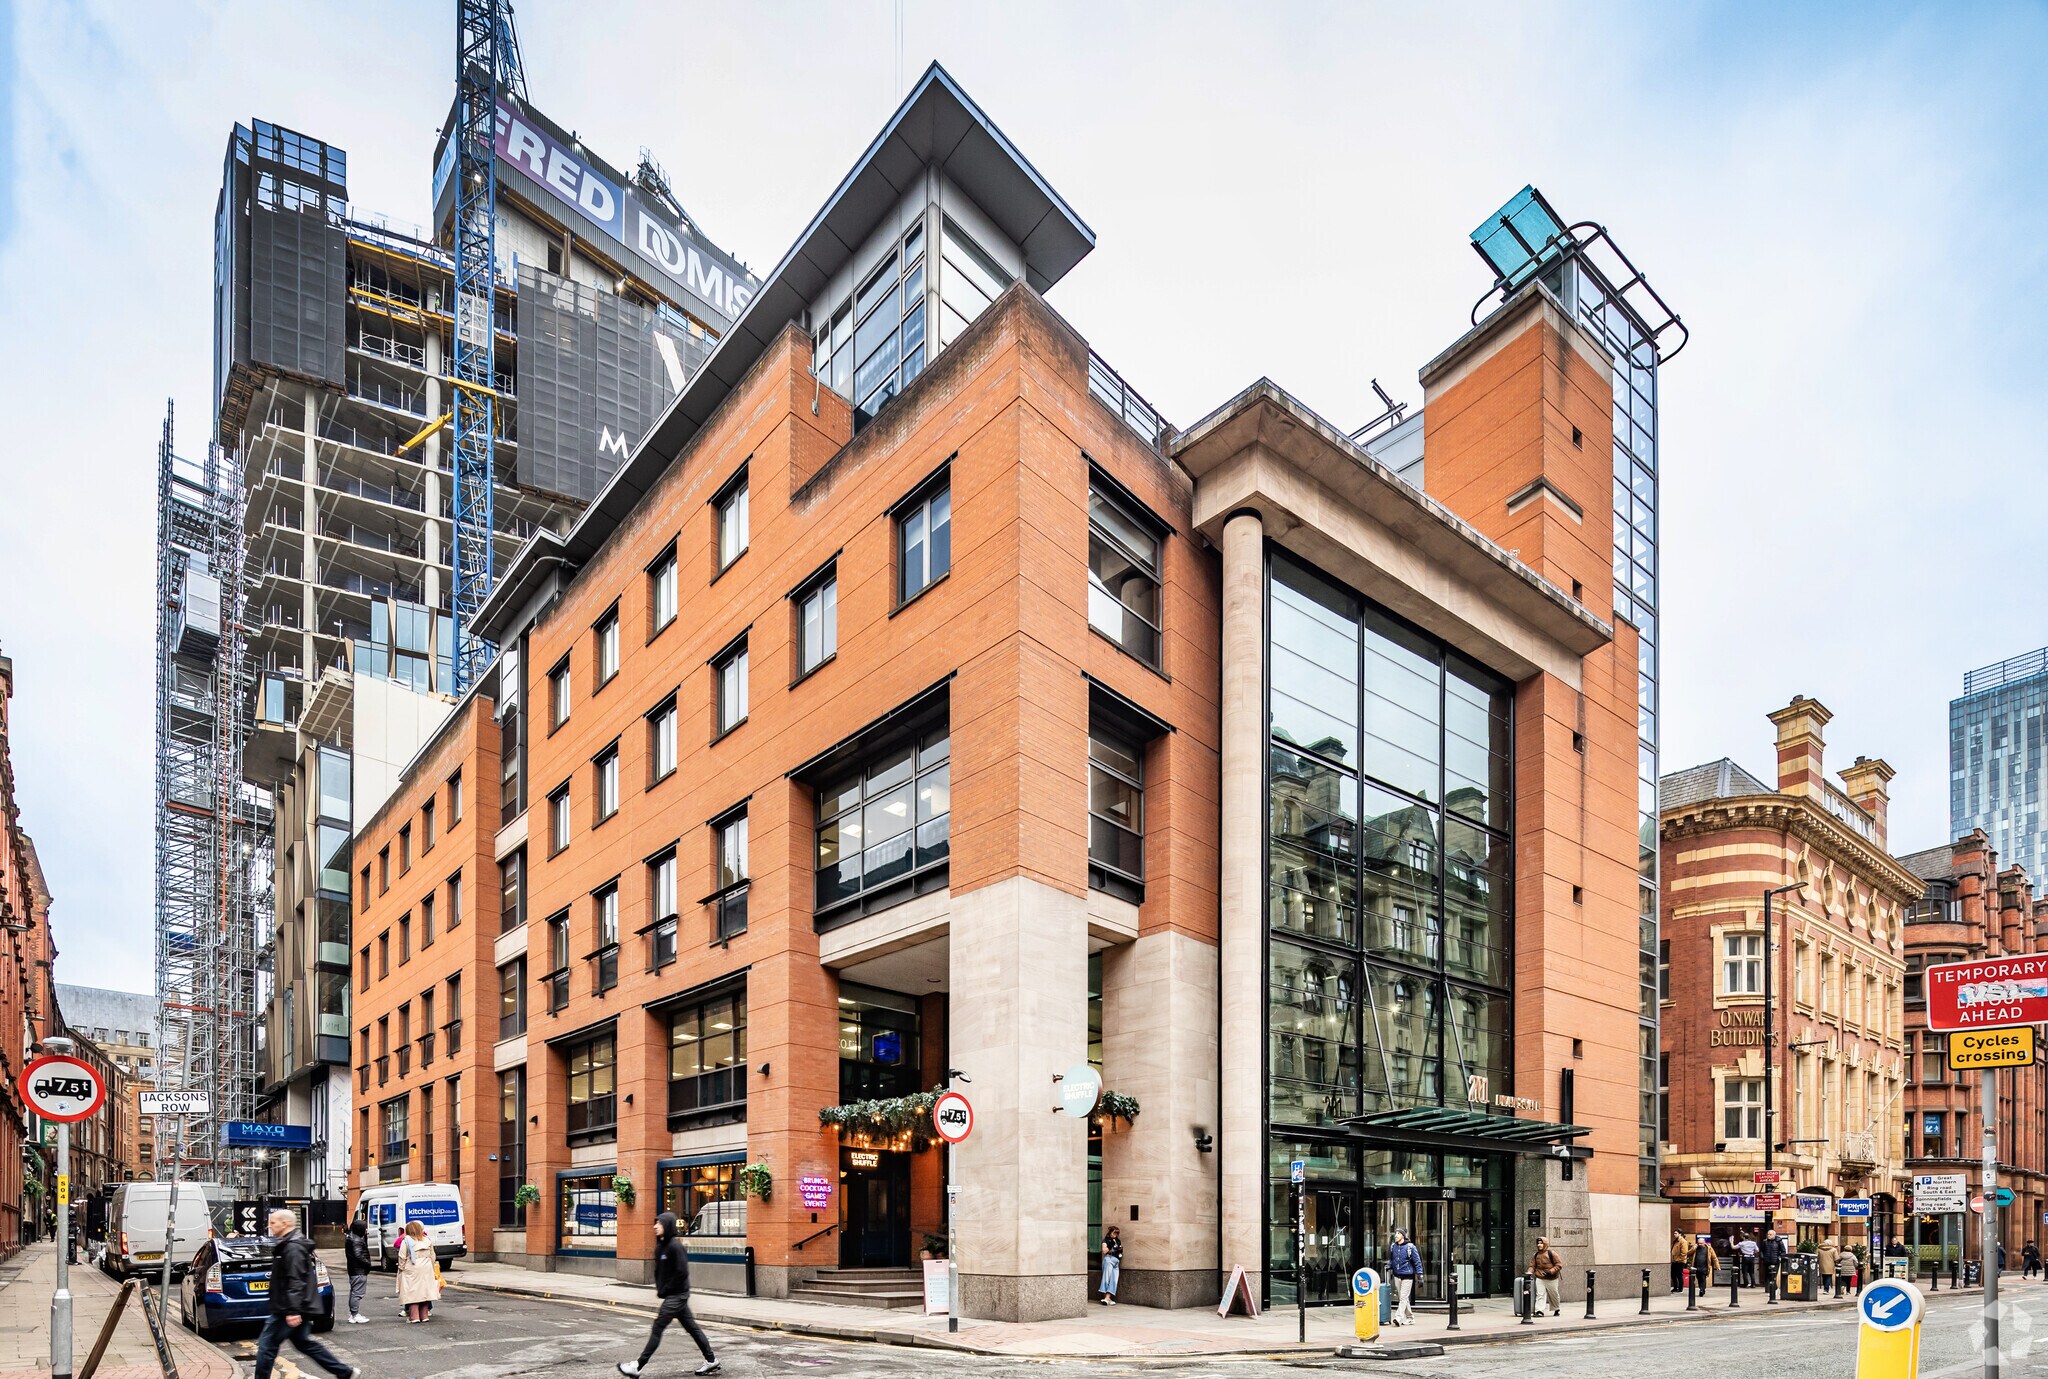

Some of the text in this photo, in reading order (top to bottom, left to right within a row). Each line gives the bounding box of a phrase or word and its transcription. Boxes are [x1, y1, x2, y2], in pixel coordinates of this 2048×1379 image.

[481, 99, 615, 222] FRED
[460, 295, 471, 338] MAYO
[1934, 960, 2047, 983] TEMPORARY
[1959, 1007, 2023, 1023] AHEAD
[1710, 1029, 1779, 1047] BUILDINS
[1963, 1035, 2019, 1049] Cycles
[1956, 1049, 2026, 1063] crossing
[1063, 1081, 1095, 1091] ELECTRIC
[142, 1092, 207, 1103] JACKSONS
[1065, 1090, 1094, 1100] SHUFFLE
[161, 1103, 191, 1112] ROW
[242, 1123, 285, 1133] MAYO
[851, 1152, 879, 1160] ELECTRIC
[852, 1159, 878, 1167] SHUFFLE
[803, 1177, 829, 1185] BRUNCH
[800, 1184, 832, 1193] COCKTAILS
[804, 1192, 827, 1200] GAMES
[805, 1200, 827, 1208] EVENTS
